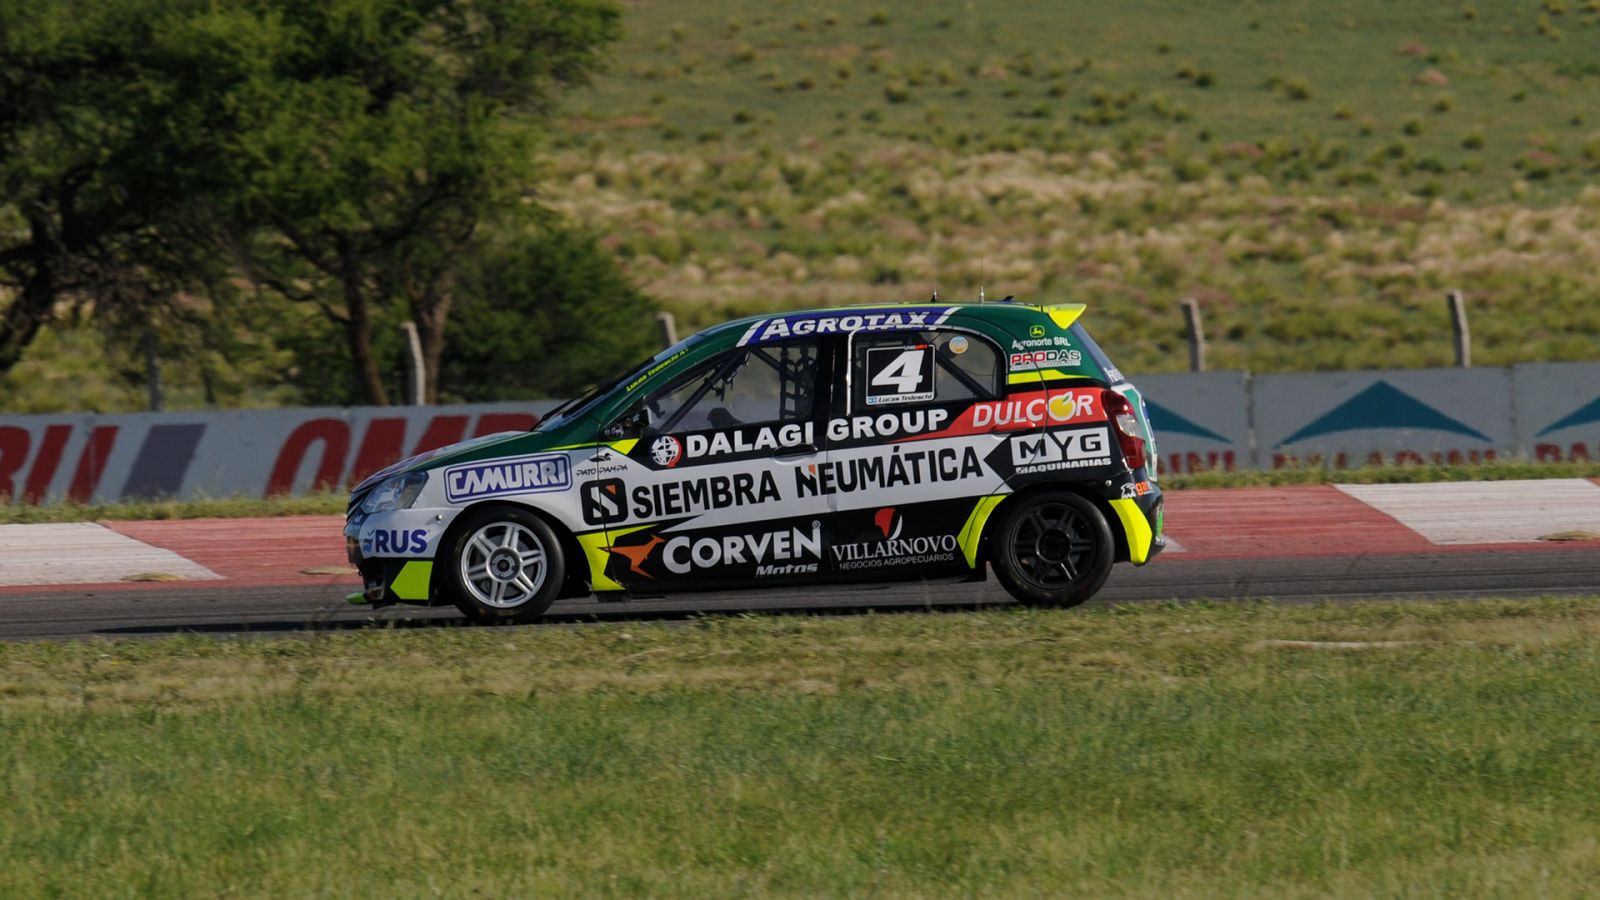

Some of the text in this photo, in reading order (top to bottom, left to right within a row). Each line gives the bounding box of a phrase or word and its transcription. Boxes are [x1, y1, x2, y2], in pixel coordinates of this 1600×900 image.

[760, 311, 931, 340] AGROTAX
[1011, 350, 1081, 365] PRODAS
[1012, 336, 1071, 351] Agronorte SRL
[871, 349, 925, 393] 4
[877, 395, 902, 404] Lucas
[972, 393, 1094, 428] DULCOR
[826, 408, 949, 441] GROUP
[686, 421, 814, 458] DALAGI
[1019, 427, 1102, 461] MYG
[448, 459, 566, 497] CAMURRI
[1015, 457, 1112, 475] MAQUINARIAS
[632, 445, 984, 519] SIEMBRA NEUMÁTICA
[376, 528, 429, 554] RUS
[662, 525, 823, 575] CORVEN
[831, 534, 957, 562] VILLARNOVO
[756, 562, 819, 577] Motos
[839, 552, 955, 570] NEGOCIOS AGROPECUARIOS
